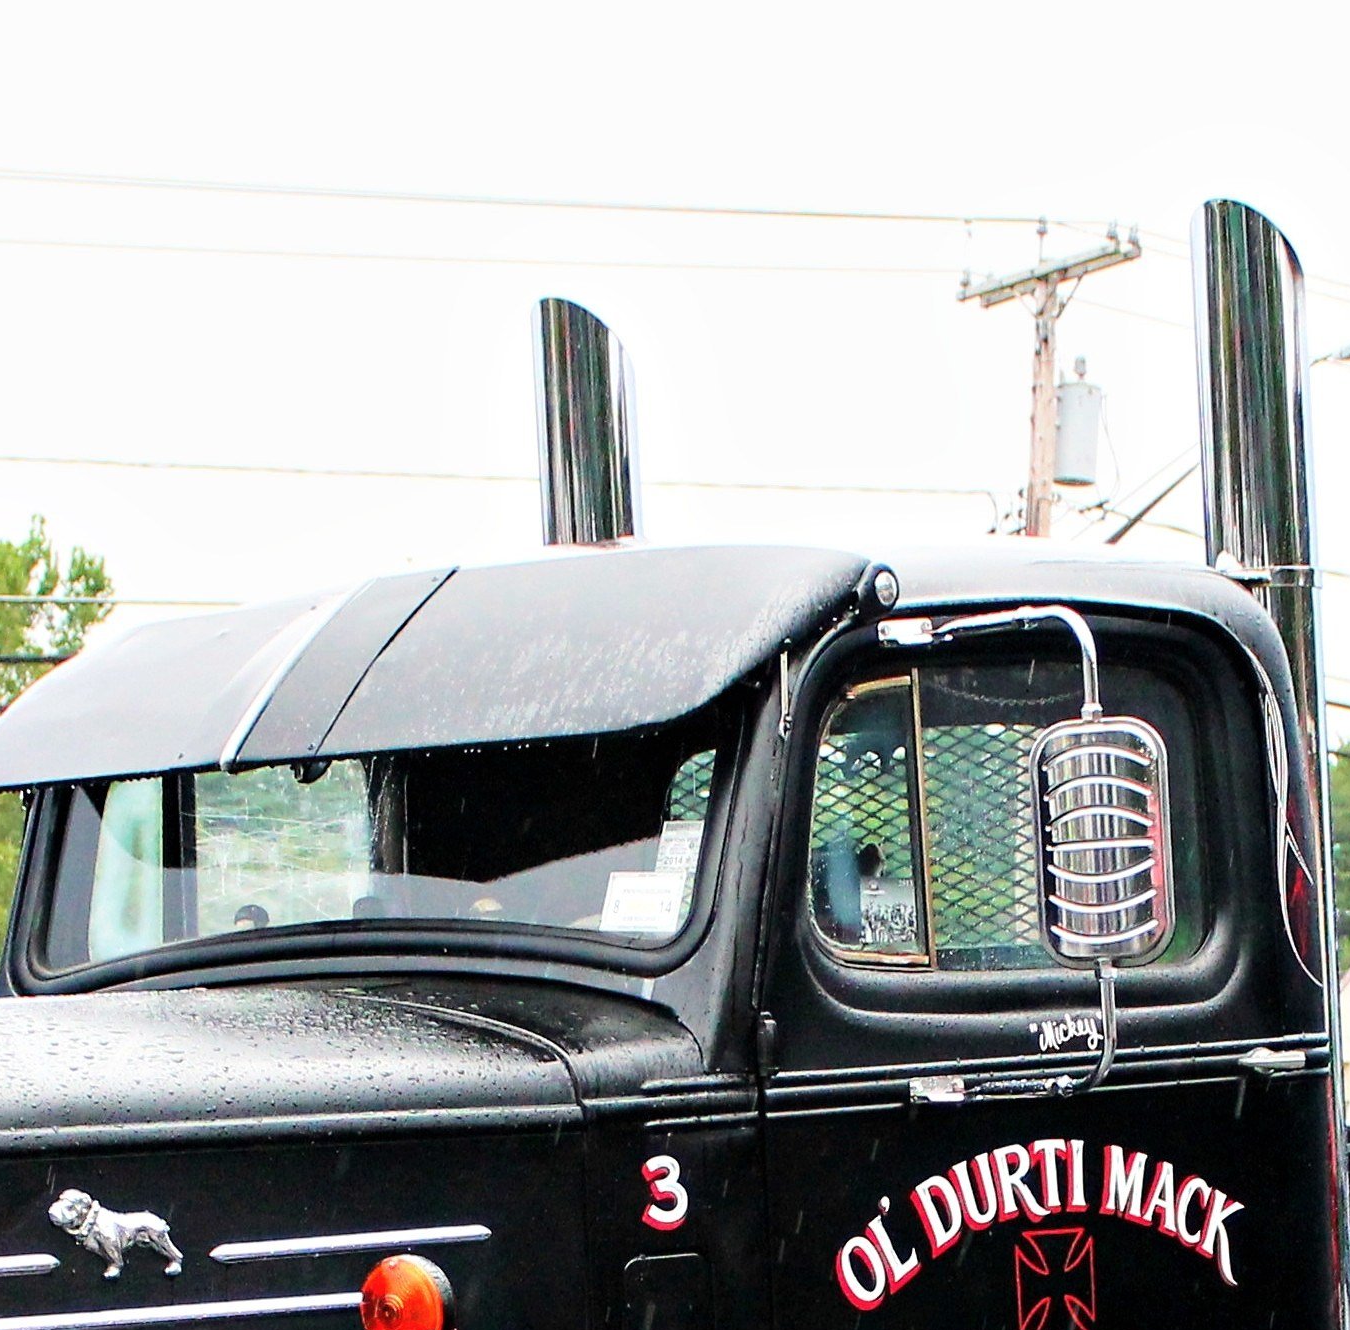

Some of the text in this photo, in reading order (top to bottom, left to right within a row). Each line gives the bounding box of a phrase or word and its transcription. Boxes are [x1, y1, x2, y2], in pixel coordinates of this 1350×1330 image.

[641, 1154, 689, 1231] 3
[910, 1138, 1089, 1258] DURTI
[1099, 1144, 1246, 1287] MACK
